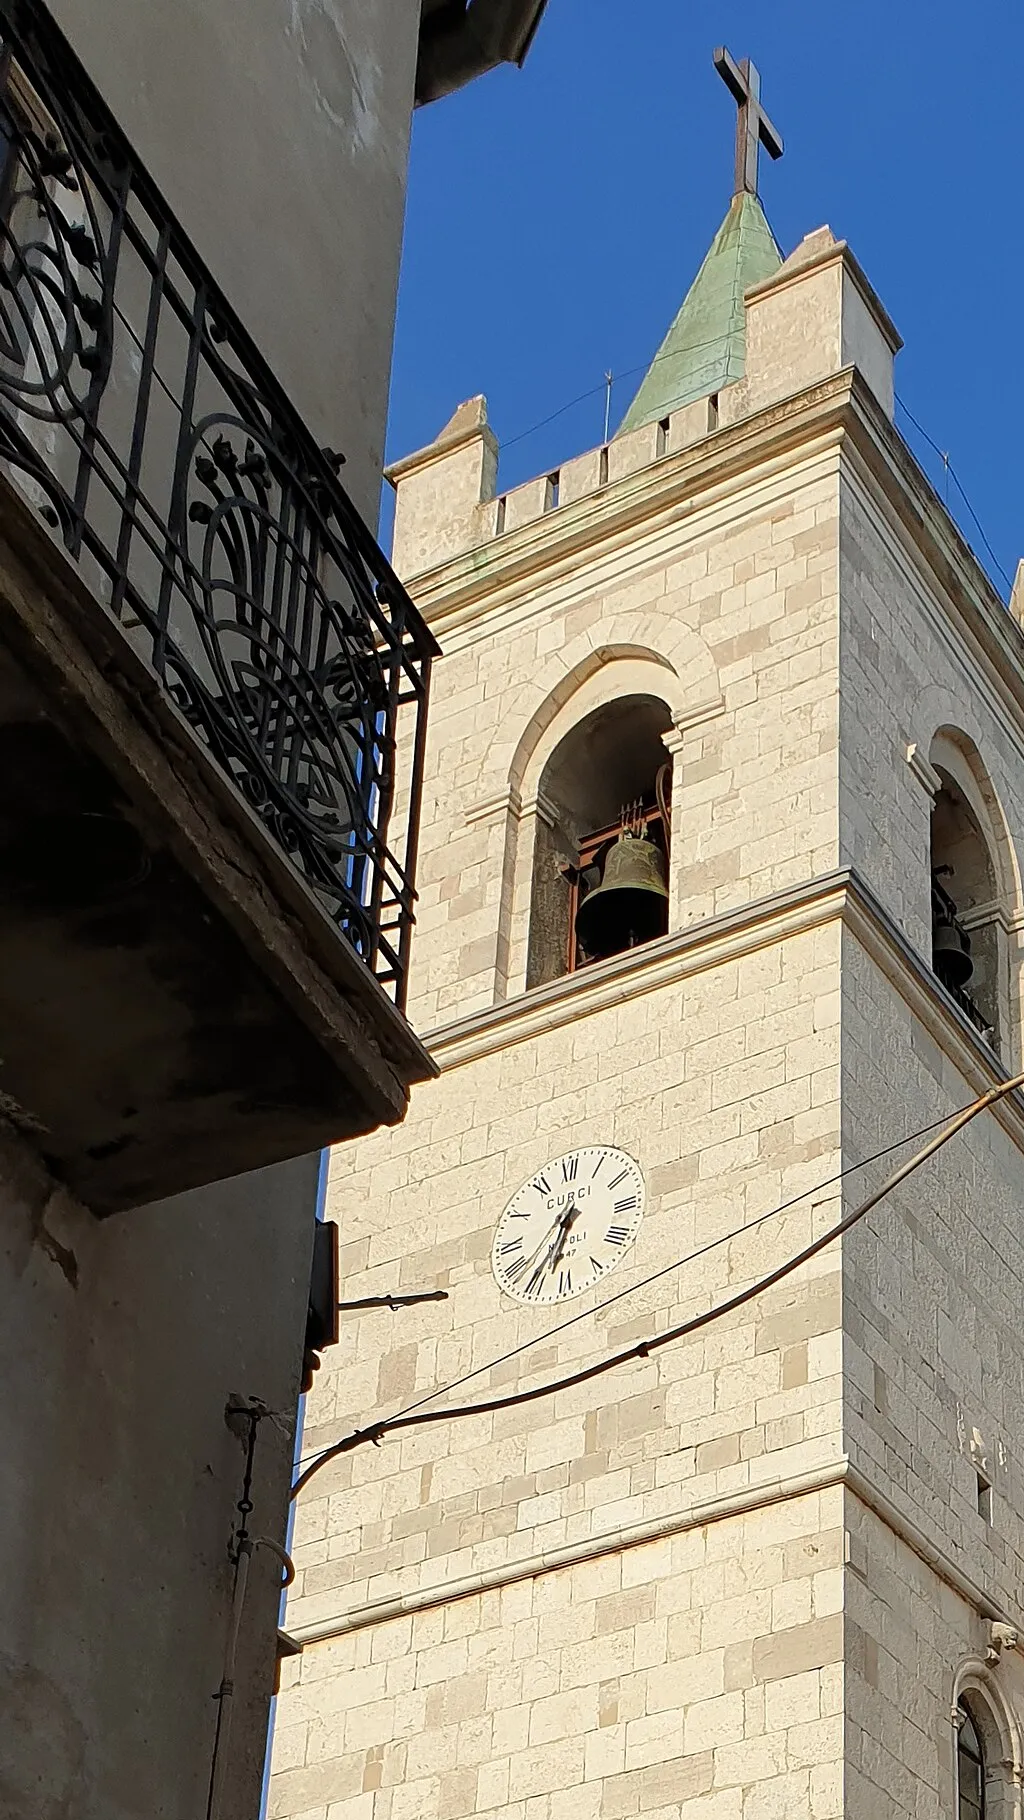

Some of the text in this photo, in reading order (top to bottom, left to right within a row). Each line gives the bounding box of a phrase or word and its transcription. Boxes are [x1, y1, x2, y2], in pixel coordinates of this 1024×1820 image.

[561, 1158, 579, 1185] XII
[607, 1169, 630, 1190] II
[532, 1176, 551, 1199] XI
[546, 1185, 591, 1210] CURCI
[510, 1209, 531, 1221] X
[614, 1196, 636, 1213] III
[501, 1236, 523, 1255] IX
[548, 1231, 587, 1254] NOLI
[589, 1256, 603, 1274] V
